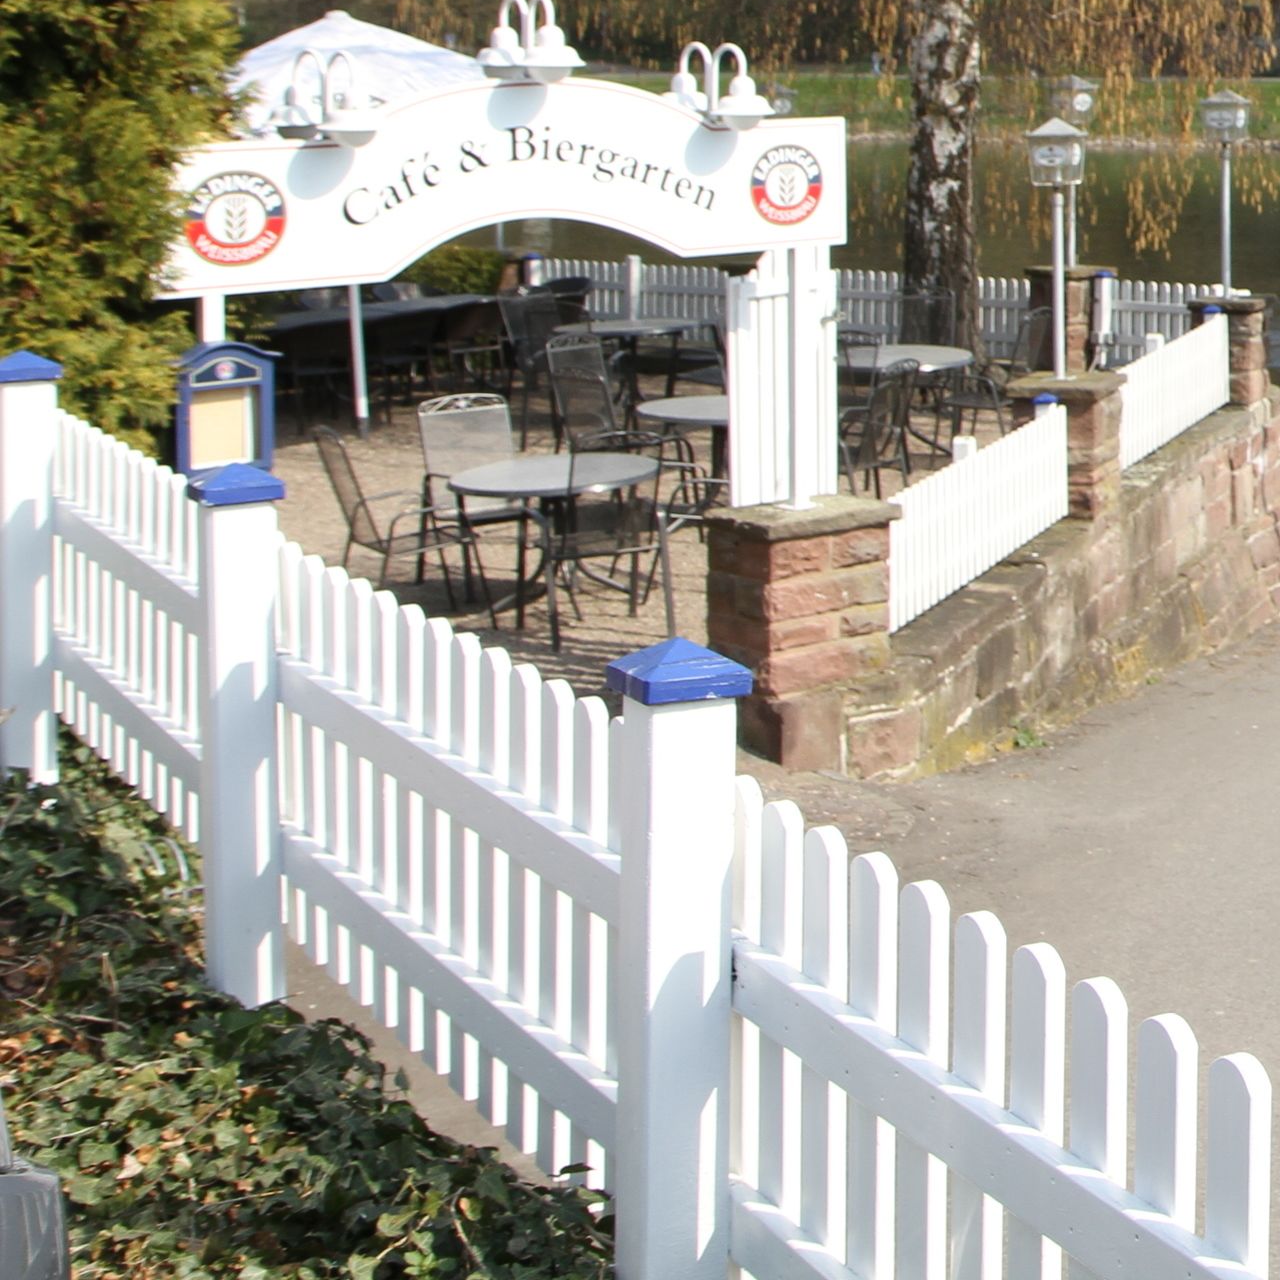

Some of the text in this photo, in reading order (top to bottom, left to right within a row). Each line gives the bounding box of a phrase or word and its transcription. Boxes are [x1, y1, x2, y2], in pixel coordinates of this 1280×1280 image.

[342, 125, 717, 228] Café & Biergarten
[754, 145, 820, 181] ERDINGER
